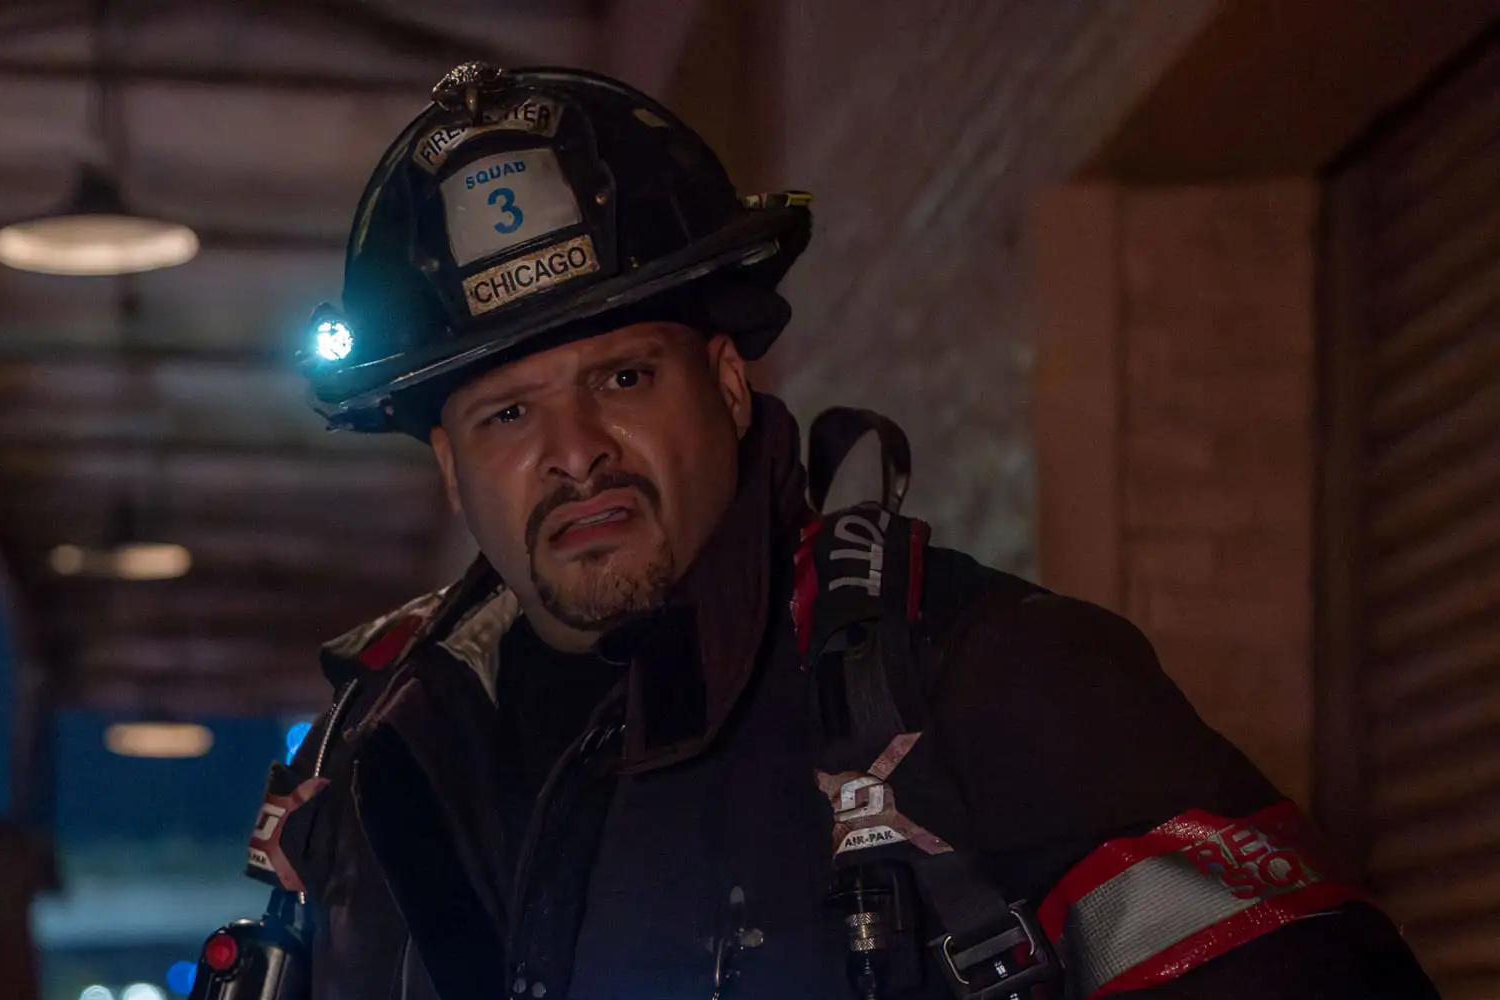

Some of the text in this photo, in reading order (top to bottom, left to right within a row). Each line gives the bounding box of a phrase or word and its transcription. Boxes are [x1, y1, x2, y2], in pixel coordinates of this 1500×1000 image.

[465, 161, 526, 189] SQUAD
[487, 187, 524, 234] 3
[474, 246, 586, 303] CHICAGO
[844, 830, 893, 848] AIR-PAK
